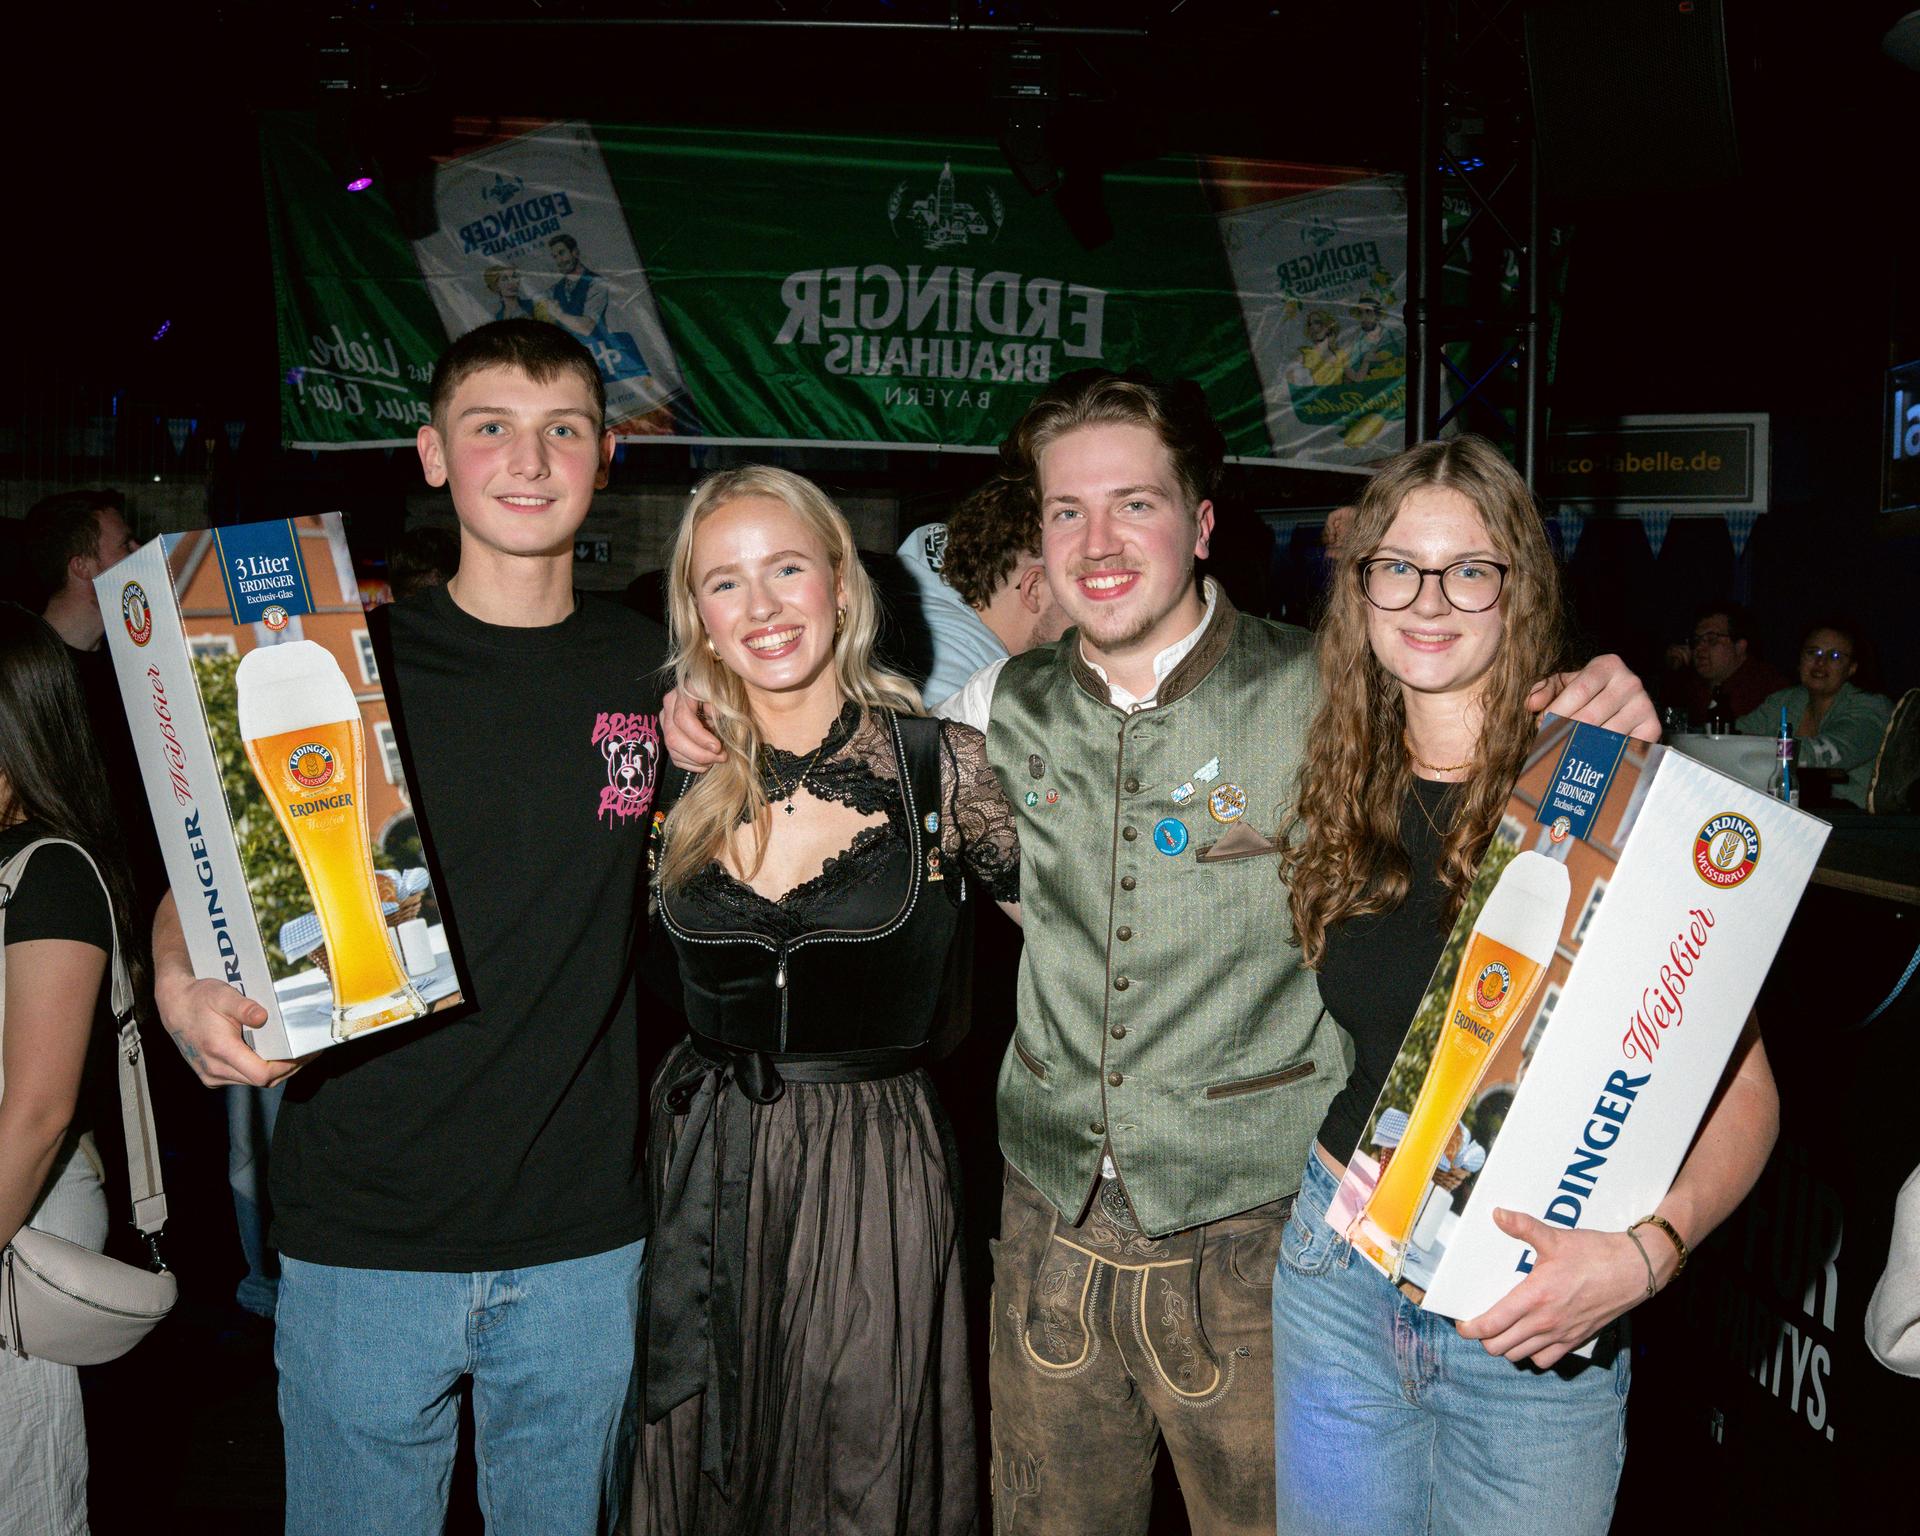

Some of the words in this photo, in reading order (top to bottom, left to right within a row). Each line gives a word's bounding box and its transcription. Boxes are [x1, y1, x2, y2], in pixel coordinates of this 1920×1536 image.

[1546, 448, 1723, 476] isco-labelle.de
[235, 558, 248, 580] 3
[248, 556, 290, 576] Liter
[239, 574, 296, 593] ERDINGER
[246, 590, 294, 604] Exclusiv-Glas
[146, 662, 194, 807] Weißbier
[290, 744, 331, 766] ERDINGER
[1562, 758, 1576, 780] 3
[1572, 760, 1604, 788] Liter
[289, 793, 354, 818] ERDINGER
[1556, 781, 1596, 805] ERDINGER
[1704, 816, 1758, 855] ERDINGER
[1623, 907, 1715, 1064] Weißbier
[1454, 1010, 1495, 1046] ERDINGER
[1515, 1068, 1652, 1275] DINGER
